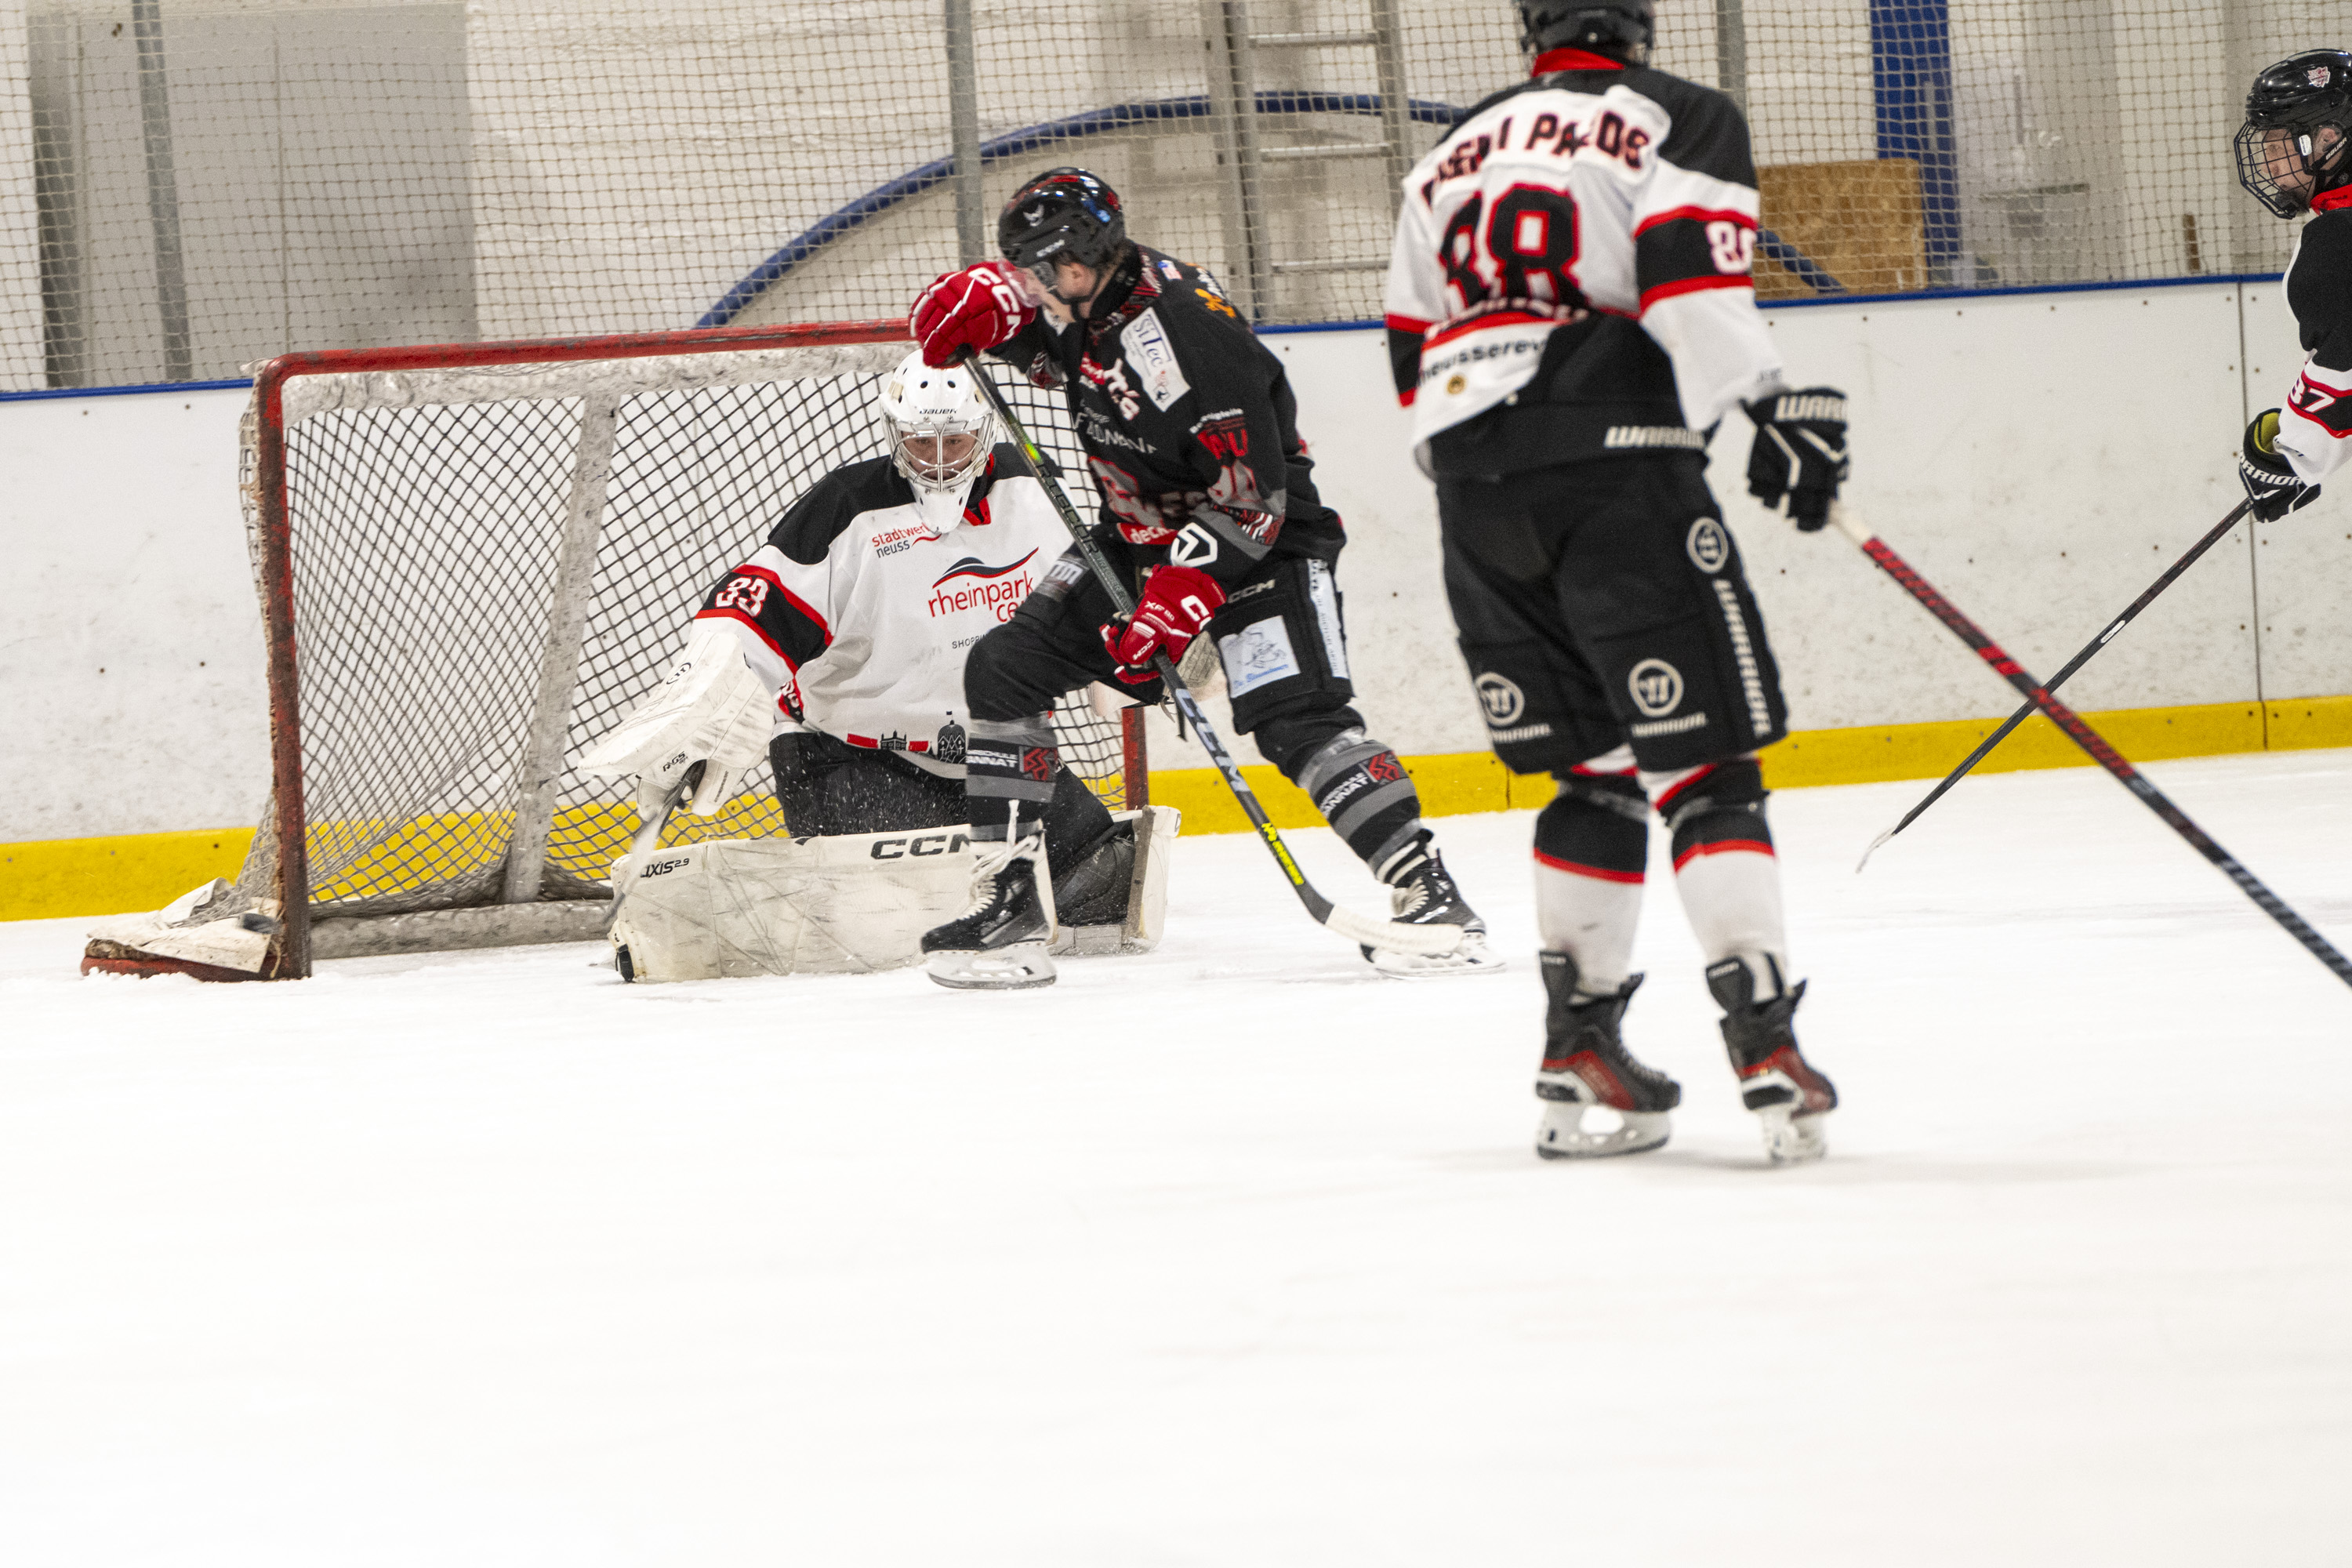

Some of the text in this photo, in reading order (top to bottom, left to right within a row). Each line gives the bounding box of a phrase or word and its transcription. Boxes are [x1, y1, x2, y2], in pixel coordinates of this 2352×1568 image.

[1035, 463, 1099, 554] RIBCOR
[876, 539, 910, 558] neuss
[715, 576, 770, 618] 33
[927, 570, 1034, 618] rheinpark
[996, 601, 1025, 622] ce
[1175, 688, 1251, 793] CCM
